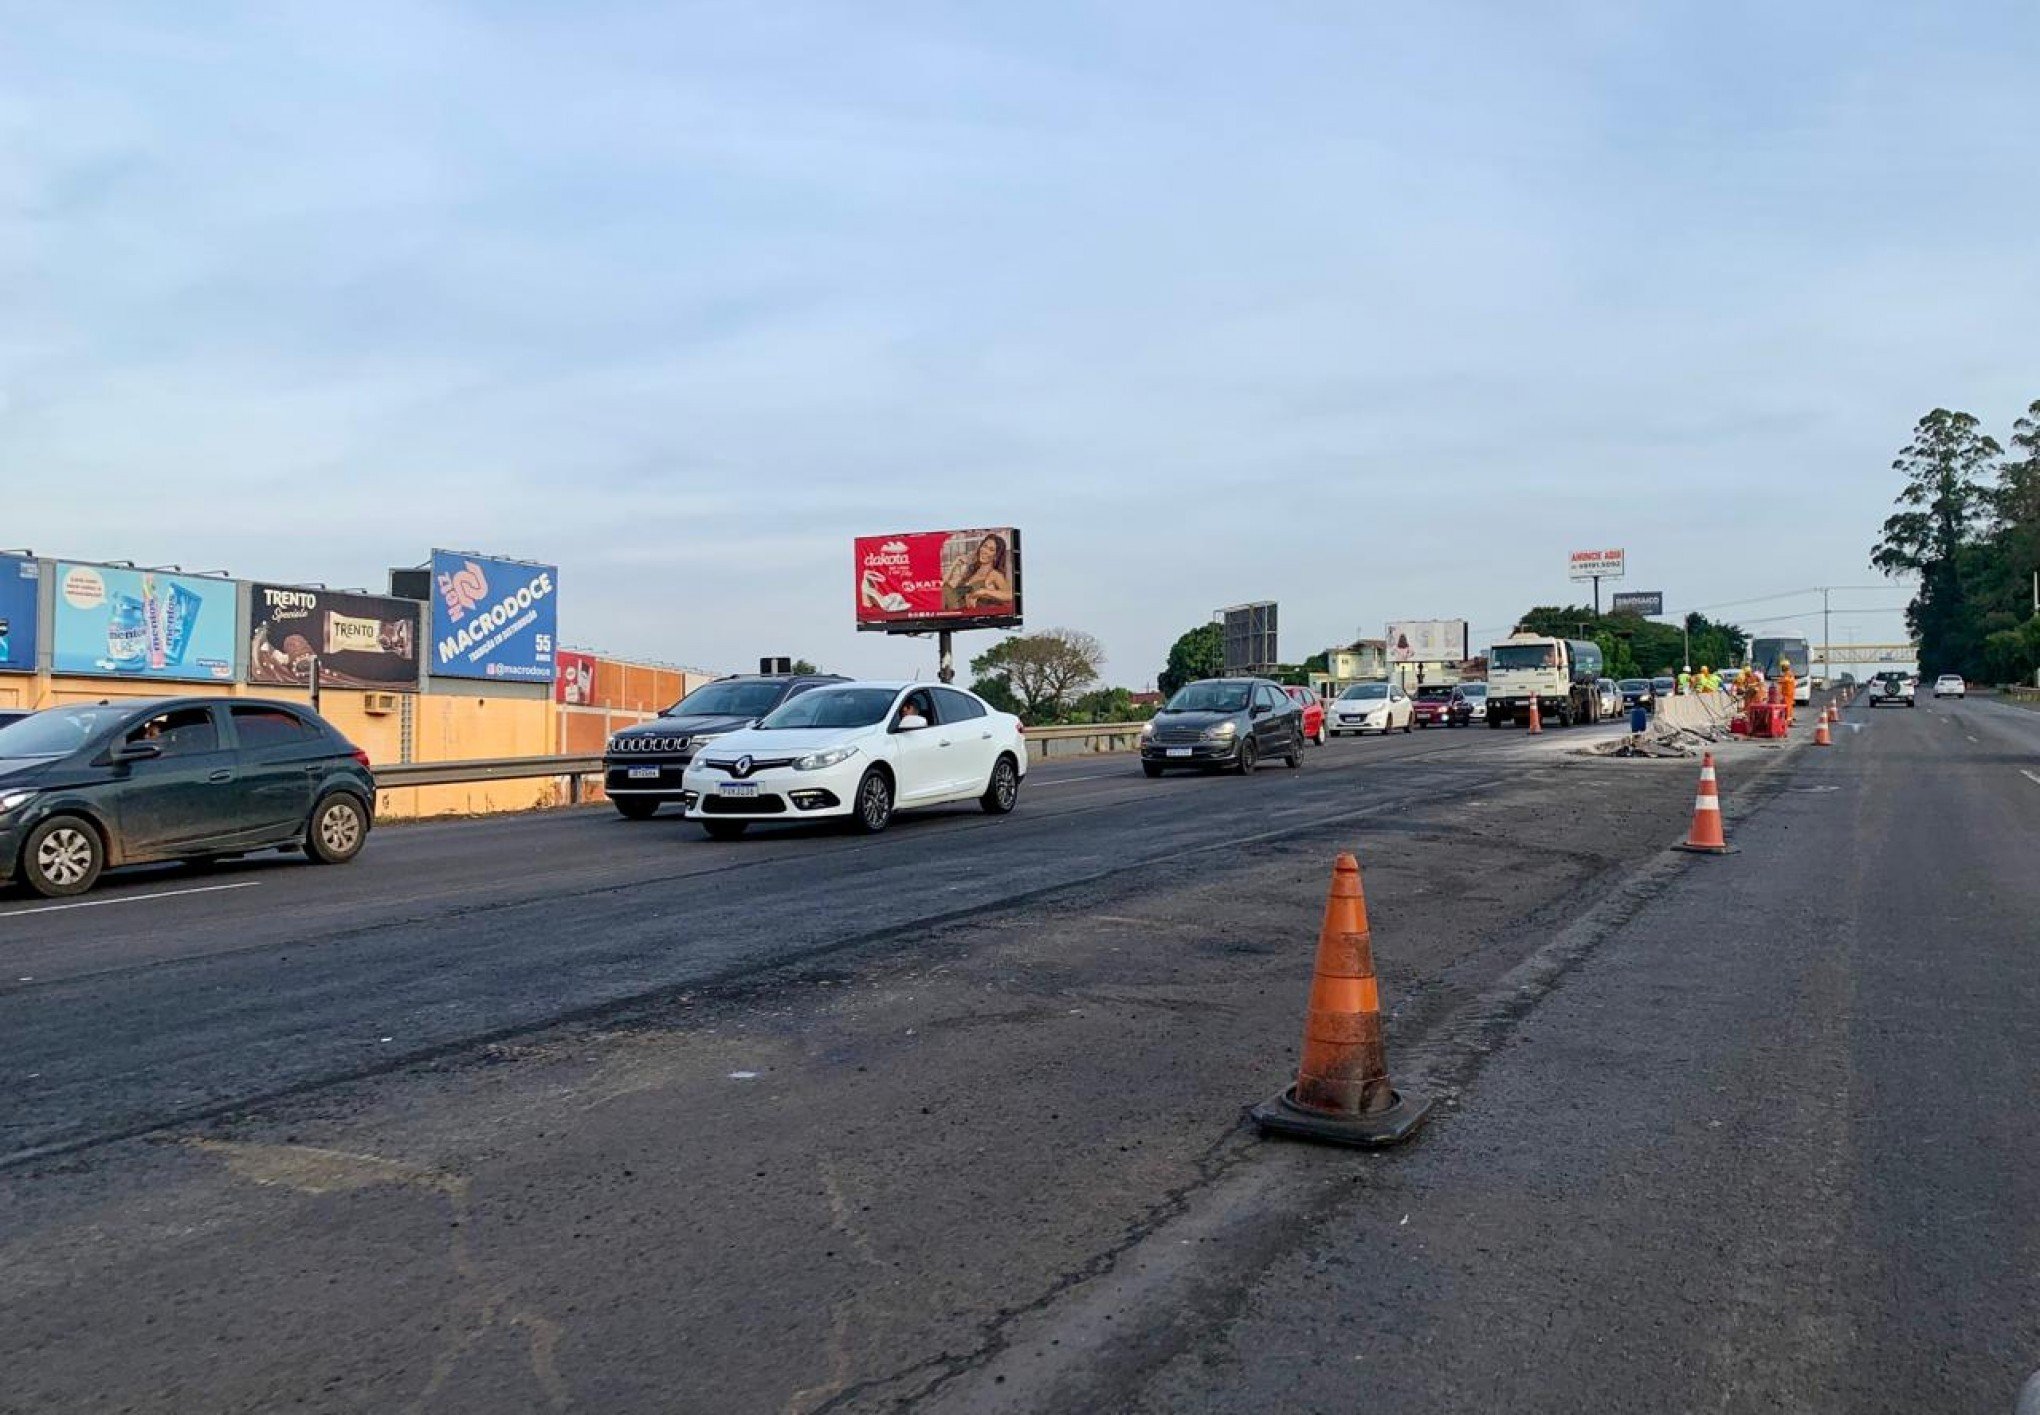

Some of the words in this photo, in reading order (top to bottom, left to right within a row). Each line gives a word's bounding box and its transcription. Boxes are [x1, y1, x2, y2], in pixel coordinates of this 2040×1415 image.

[864, 551, 910, 567] dakota
[264, 589, 316, 609] TRENTO
[438, 572, 554, 663] MACRODOCE
[334, 622, 374, 638] TRENTO
[535, 634, 551, 652] 55
